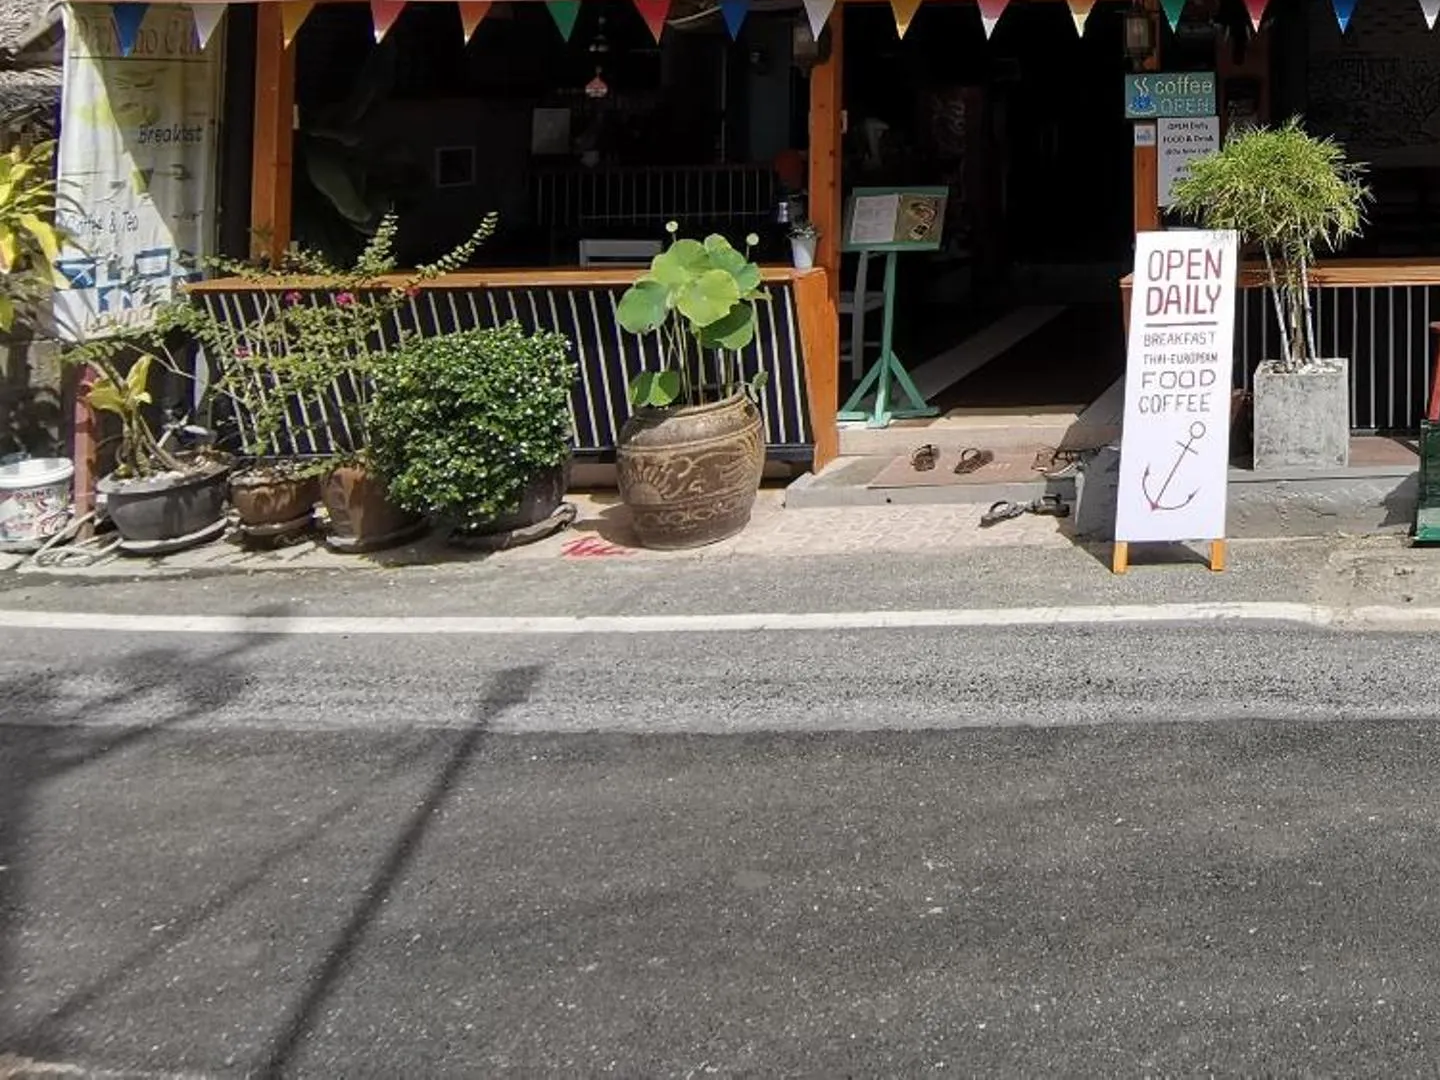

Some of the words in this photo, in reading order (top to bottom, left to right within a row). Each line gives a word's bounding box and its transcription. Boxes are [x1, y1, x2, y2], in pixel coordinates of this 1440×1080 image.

[1155, 75, 1213, 95] coffee
[1161, 98, 1216, 115] OPEN
[1147, 248, 1223, 282] OPEN
[1146, 285, 1222, 317] DAILY
[1143, 331, 1217, 347] BREAKFAST
[1142, 370, 1216, 390] FOOD
[1138, 393, 1212, 415] COFFEE
